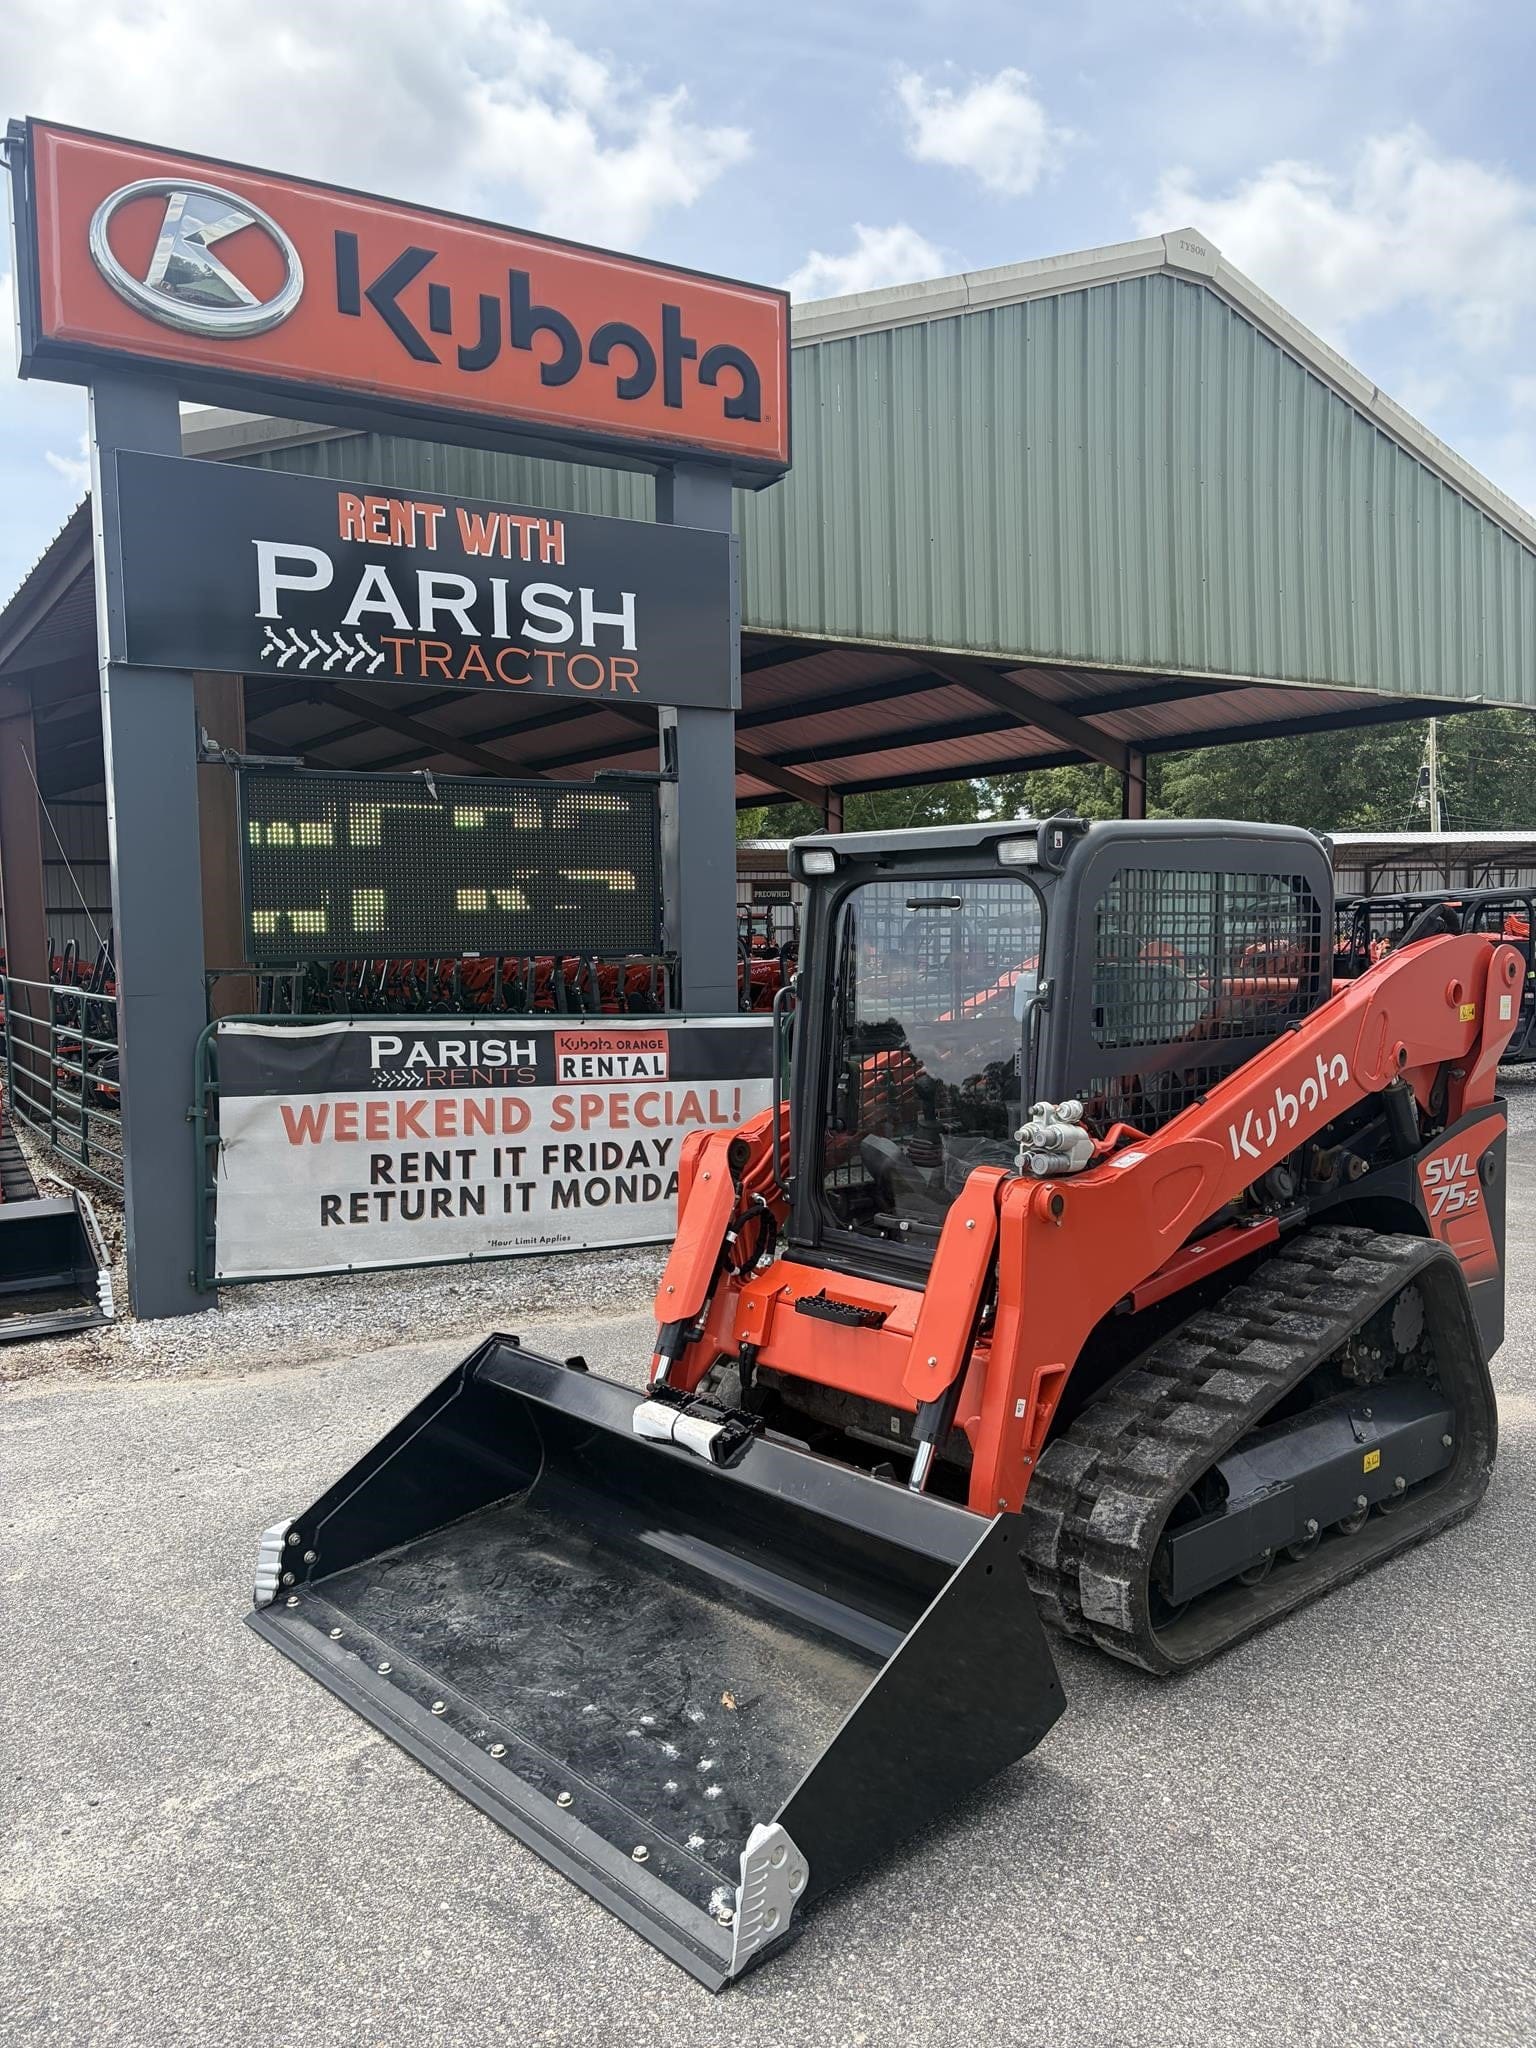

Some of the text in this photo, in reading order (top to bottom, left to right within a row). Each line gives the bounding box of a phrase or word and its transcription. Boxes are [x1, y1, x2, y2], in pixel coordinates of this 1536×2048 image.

[1180, 240, 1206, 256] TYSON
[334, 229, 762, 424] Kubota
[338, 492, 566, 565] RENT WITH
[252, 539, 638, 650] PARISH
[381, 635, 640, 693] TRACTOR
[754, 890, 790, 898] PREOWNED
[369, 1035, 538, 1069] PARISH
[560, 1037, 664, 1051] Kubota ORANGE
[426, 1067, 536, 1087] RENTS
[563, 1056, 665, 1078] RENTAL
[280, 1087, 742, 1146] WEEKEND SPECIAL!
[1227, 1052, 1350, 1161] Kubota
[370, 1137, 674, 1186] RENT IT FRIDAY
[1423, 1153, 1477, 1187] SVL
[320, 1170, 679, 1227] RETURN IT MONDA
[515, 1237, 538, 1245] Limit
[539, 1233, 572, 1244] Applies
